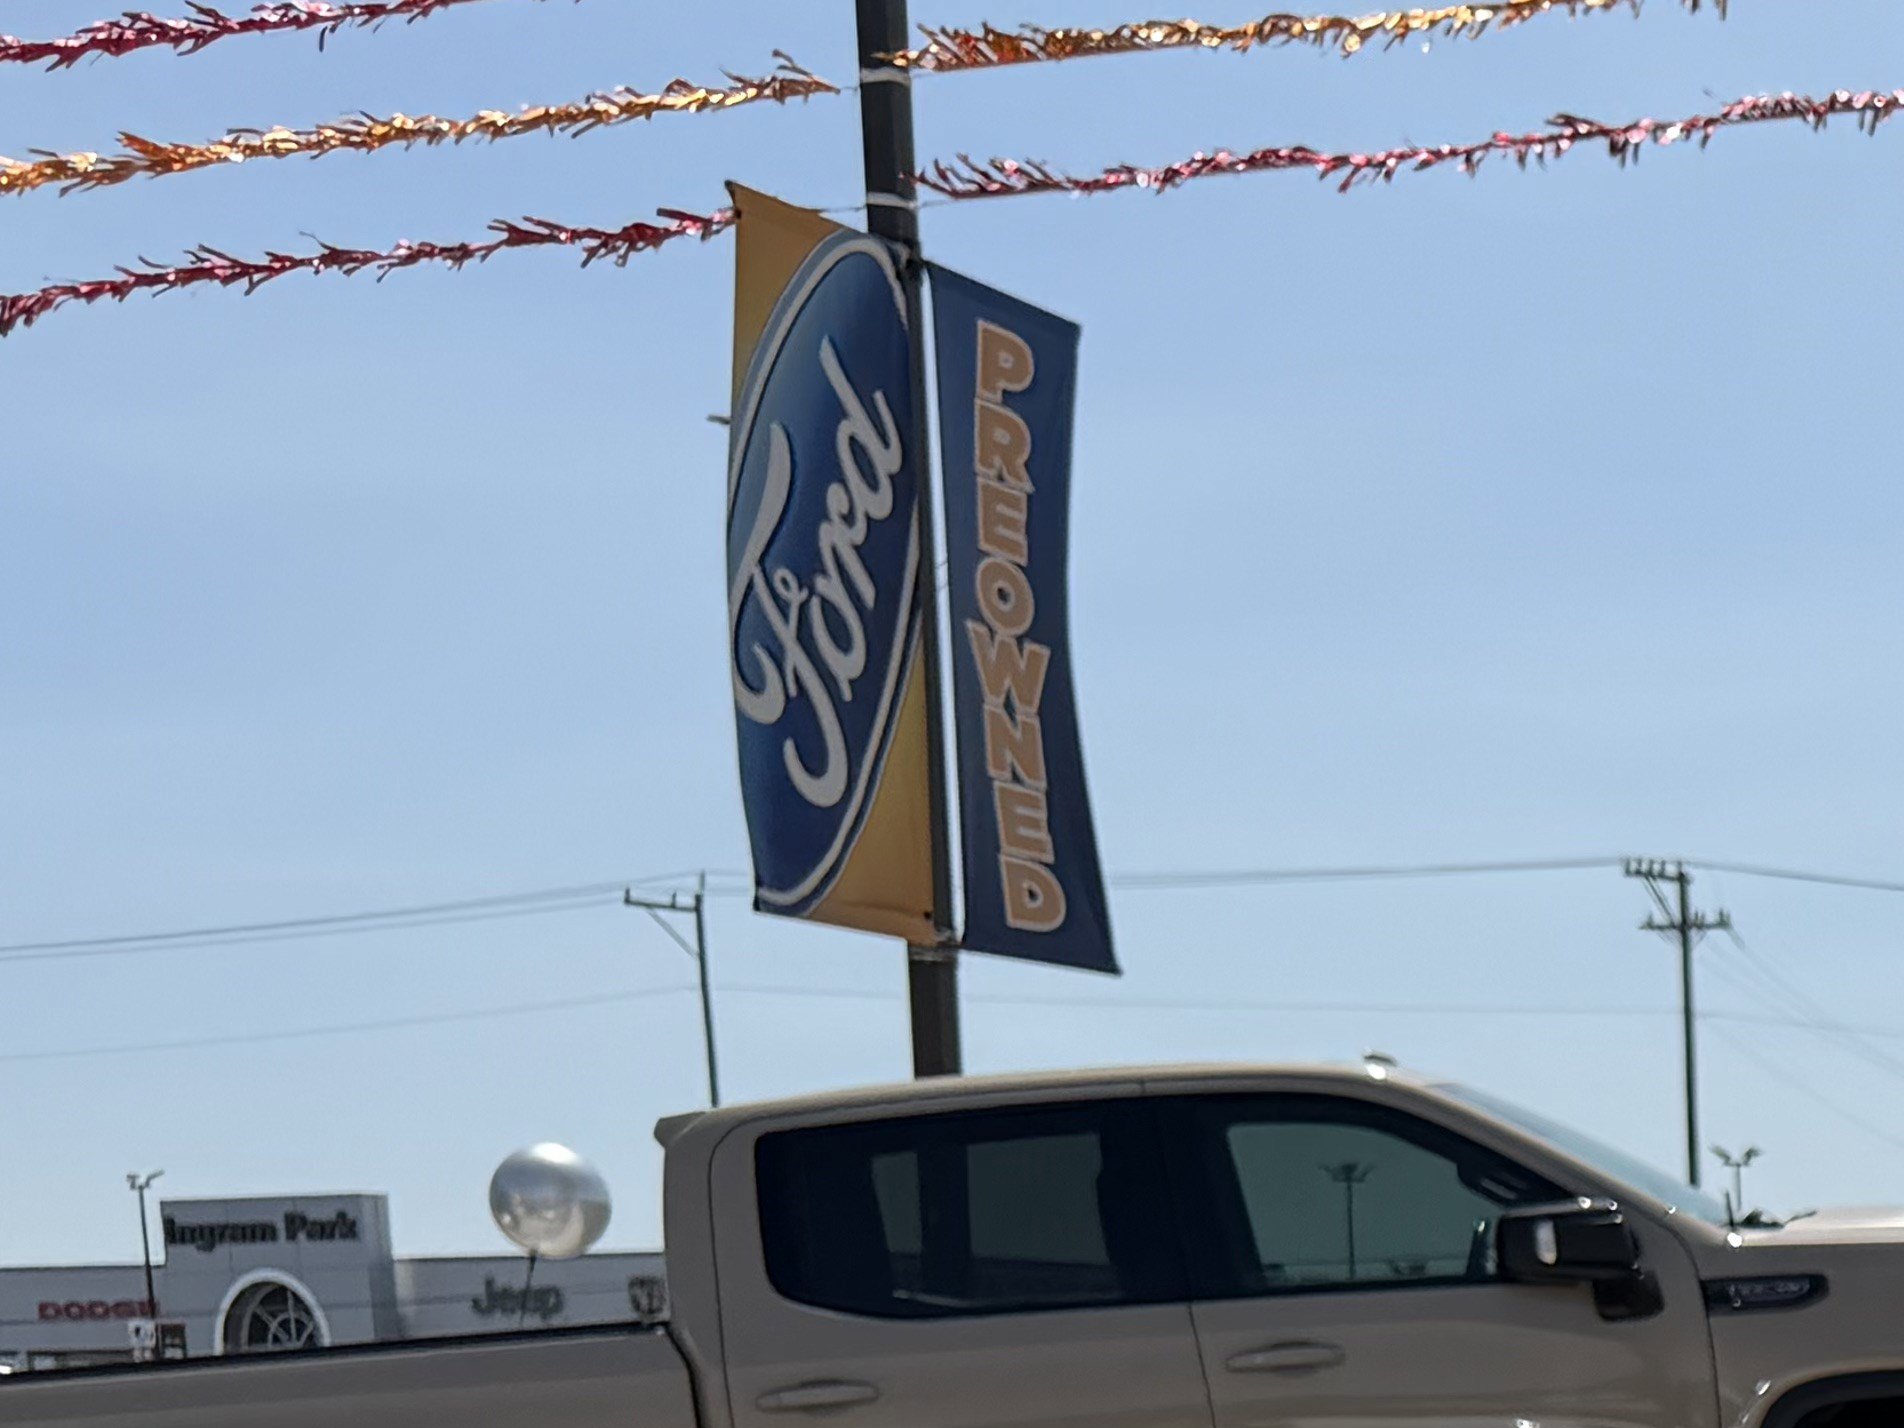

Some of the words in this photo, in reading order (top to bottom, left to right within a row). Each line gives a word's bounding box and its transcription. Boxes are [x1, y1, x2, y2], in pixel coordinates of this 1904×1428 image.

[730, 335, 904, 808] Ford
[965, 319, 1067, 934] PREOWNED
[164, 1214, 277, 1252] Ingram
[283, 1209, 358, 1242] Park
[471, 1276, 565, 1322] Jeep
